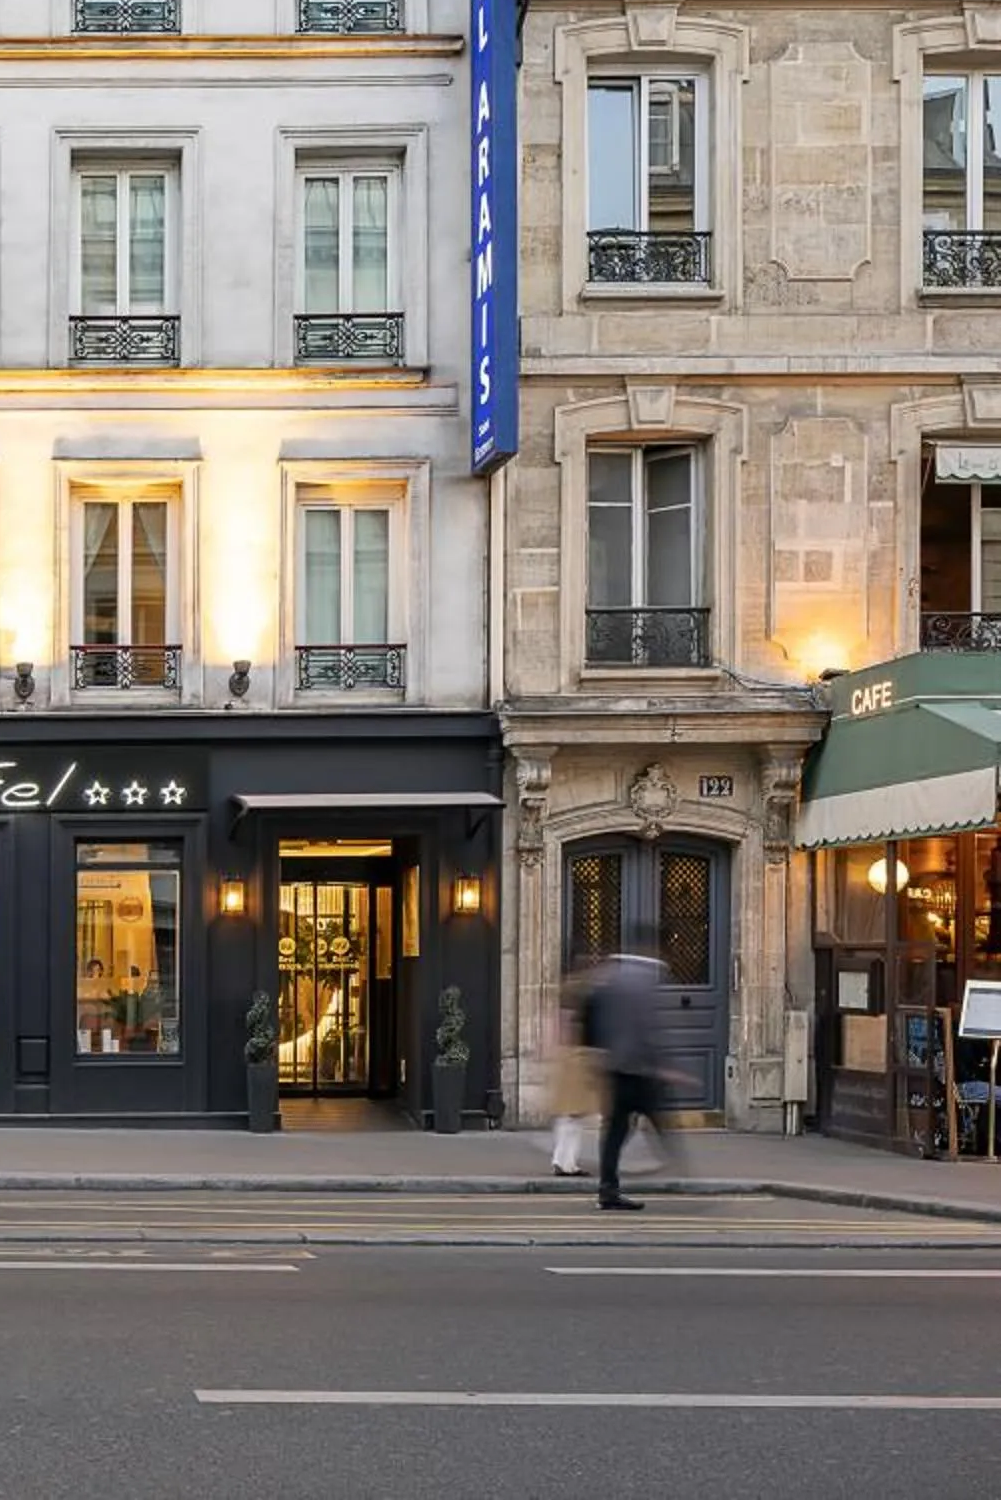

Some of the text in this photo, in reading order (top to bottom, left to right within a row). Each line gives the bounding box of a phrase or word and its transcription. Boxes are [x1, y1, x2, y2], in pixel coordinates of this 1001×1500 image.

[476, 80, 492, 405] ARAMIS
[851, 681, 893, 715] CAFE
[702, 777, 731, 796] 122
